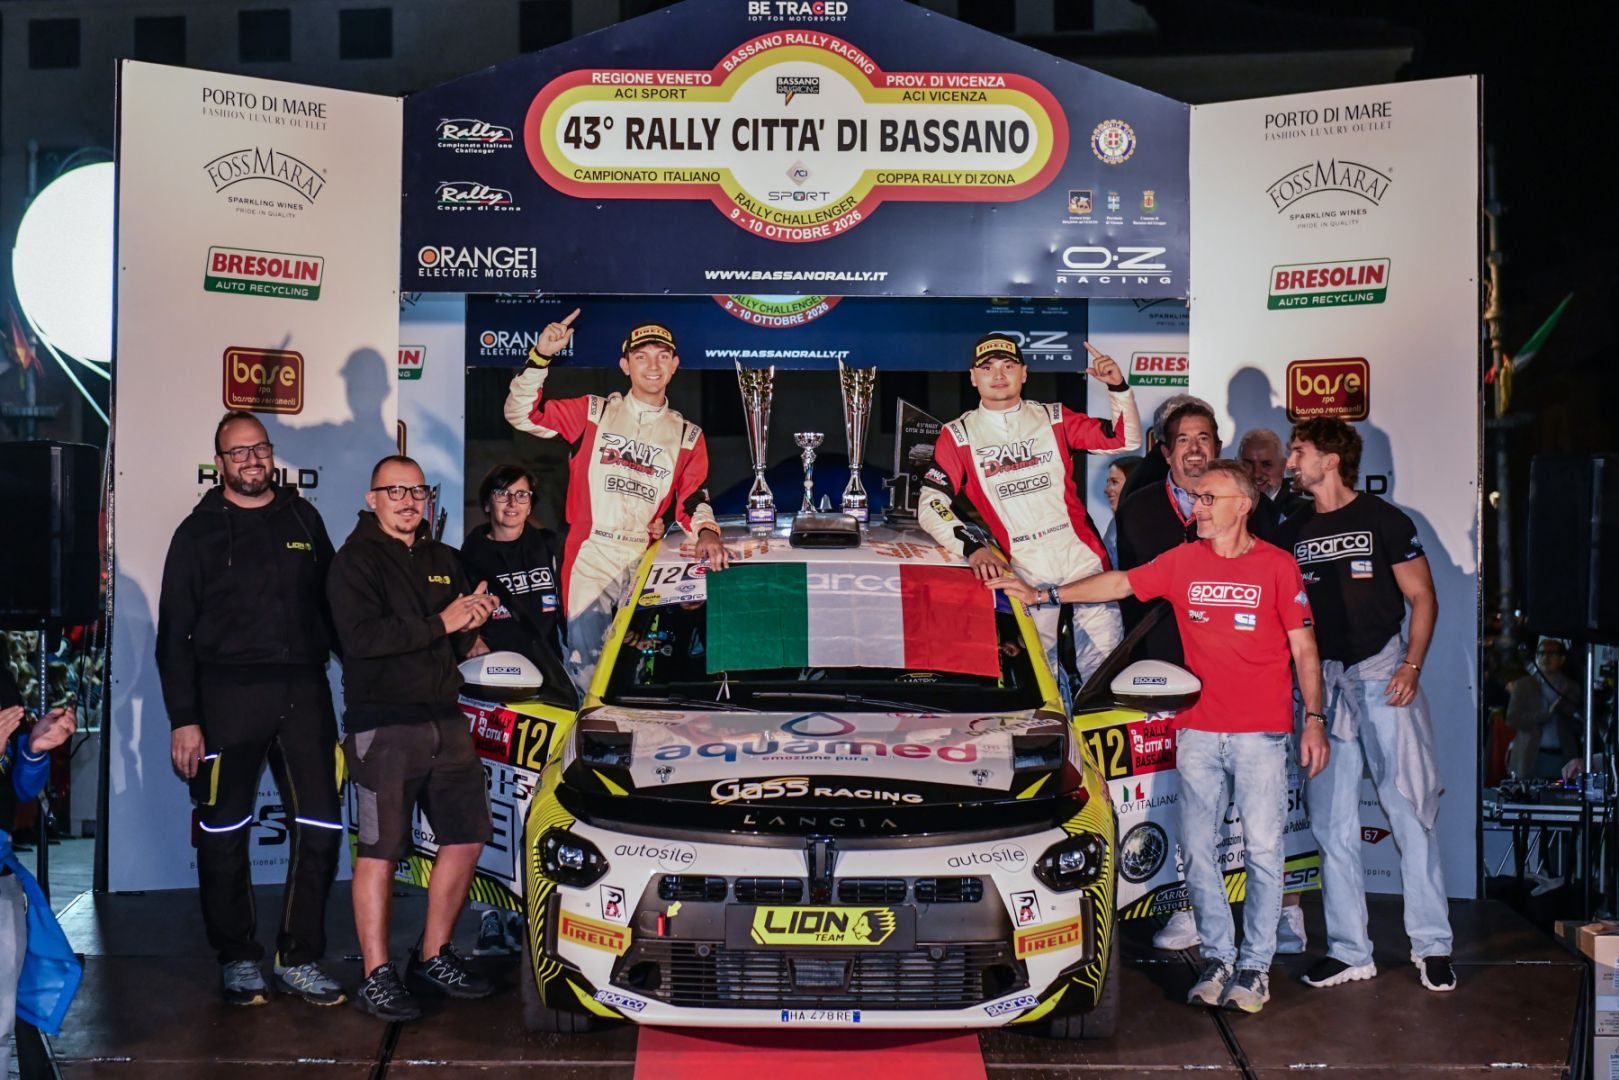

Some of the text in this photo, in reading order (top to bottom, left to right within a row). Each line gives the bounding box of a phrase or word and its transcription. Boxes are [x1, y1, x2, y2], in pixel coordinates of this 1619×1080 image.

[748, 1, 848, 15] BE TRACED
[723, 33, 875, 75] BASSANO RALLY RACING
[592, 72, 713, 86] REGIONE VENETO
[778, 77, 819, 85] BASSANO
[886, 75, 1006, 88] PROV. DI VICENZA
[202, 87, 327, 119] PORTO DI MARE
[615, 88, 687, 99] ACI SPORT
[902, 91, 987, 102] ACI VICENZA
[202, 107, 327, 131] FASHION LUXURY OUTLET
[1265, 101, 1393, 129] PORTO DI MARE
[443, 123, 504, 142] Rally
[563, 116, 1030, 154] 43° RALLY CITTA' DI BASSANO
[1265, 121, 1393, 141] FASHION LUXURY OUTLET
[574, 169, 721, 182] CAMPIONATO ITALIANO
[876, 172, 1016, 185] COPPA RALLY DI ZONA
[227, 196, 304, 211] SPARKLING WINES
[442, 185, 503, 205] Rally
[768, 191, 830, 201] SPORT
[734, 192, 857, 225] RALLY CHALLENGER
[1289, 208, 1368, 221] SPARKLING WINES
[730, 208, 862, 239] 9 10 OTTOBRE 2026
[212, 252, 319, 281] BRESOLIN
[418, 245, 537, 269] ORANGE1
[418, 268, 537, 278] ELECTRIC MOTORS
[705, 270, 888, 282] WWW.BASSANORALLY.IT
[1057, 276, 1172, 285] RACING
[1275, 264, 1385, 291] BRESOLIN
[215, 280, 309, 297] AUTO RECYCLING
[1278, 291, 1374, 307] AUTO RECYCLING
[725, 300, 829, 325] 9 10 OTTOBRE 2026
[480, 347, 528, 356] ELECTRIC
[233, 354, 297, 386] base
[1296, 367, 1361, 396] base
[607, 477, 656, 500] sparco
[998, 475, 1049, 497] sparco
[1297, 535, 1369, 559] sparco
[499, 570, 551, 588] parco
[652, 566, 682, 585] 12
[1191, 583, 1257, 601] sparco
[487, 667, 521, 675] sparco
[1133, 677, 1167, 685] sparco
[1143, 725, 1169, 738] RALLY
[516, 718, 548, 771] 12
[655, 740, 977, 763] aquamed
[1089, 728, 1127, 779] 12
[1136, 752, 1173, 768] BASSANO
[814, 787, 924, 804] RACING
[743, 813, 898, 828] LANCIA
[614, 842, 695, 864] autosile
[948, 848, 1026, 868] autosile
[764, 910, 849, 934] LION
[562, 916, 625, 951] PIRELLI
[815, 933, 845, 942] TEAM
[1018, 922, 1080, 954] PIRELLI
[595, 990, 645, 1010] sparco
[985, 995, 1036, 1015] sparco
[790, 1011, 806, 1021] HA
